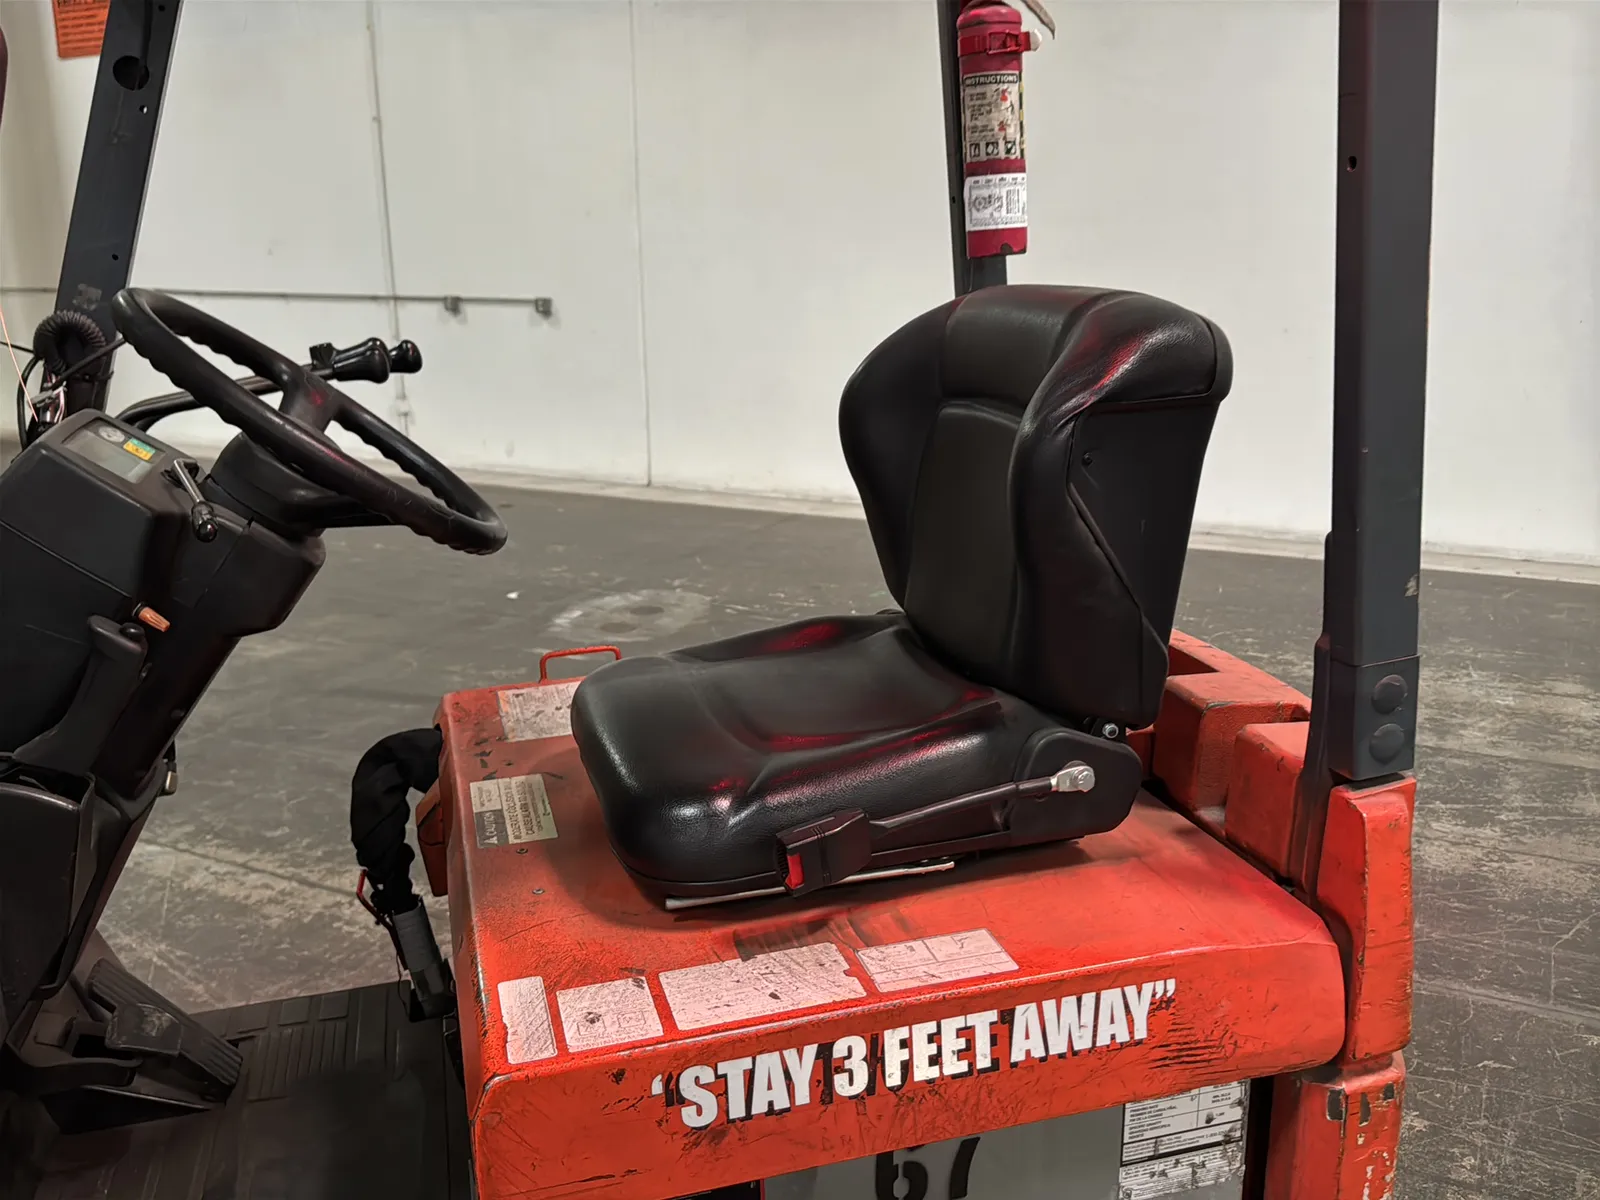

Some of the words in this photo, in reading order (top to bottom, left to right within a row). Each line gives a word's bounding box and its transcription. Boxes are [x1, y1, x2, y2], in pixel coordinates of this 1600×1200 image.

[965, 74, 1017, 85] INSTRUCTIONS
[483, 812, 497, 836] CAUTION
[833, 1035, 868, 1098] 3
[883, 1010, 998, 1087] FEET
